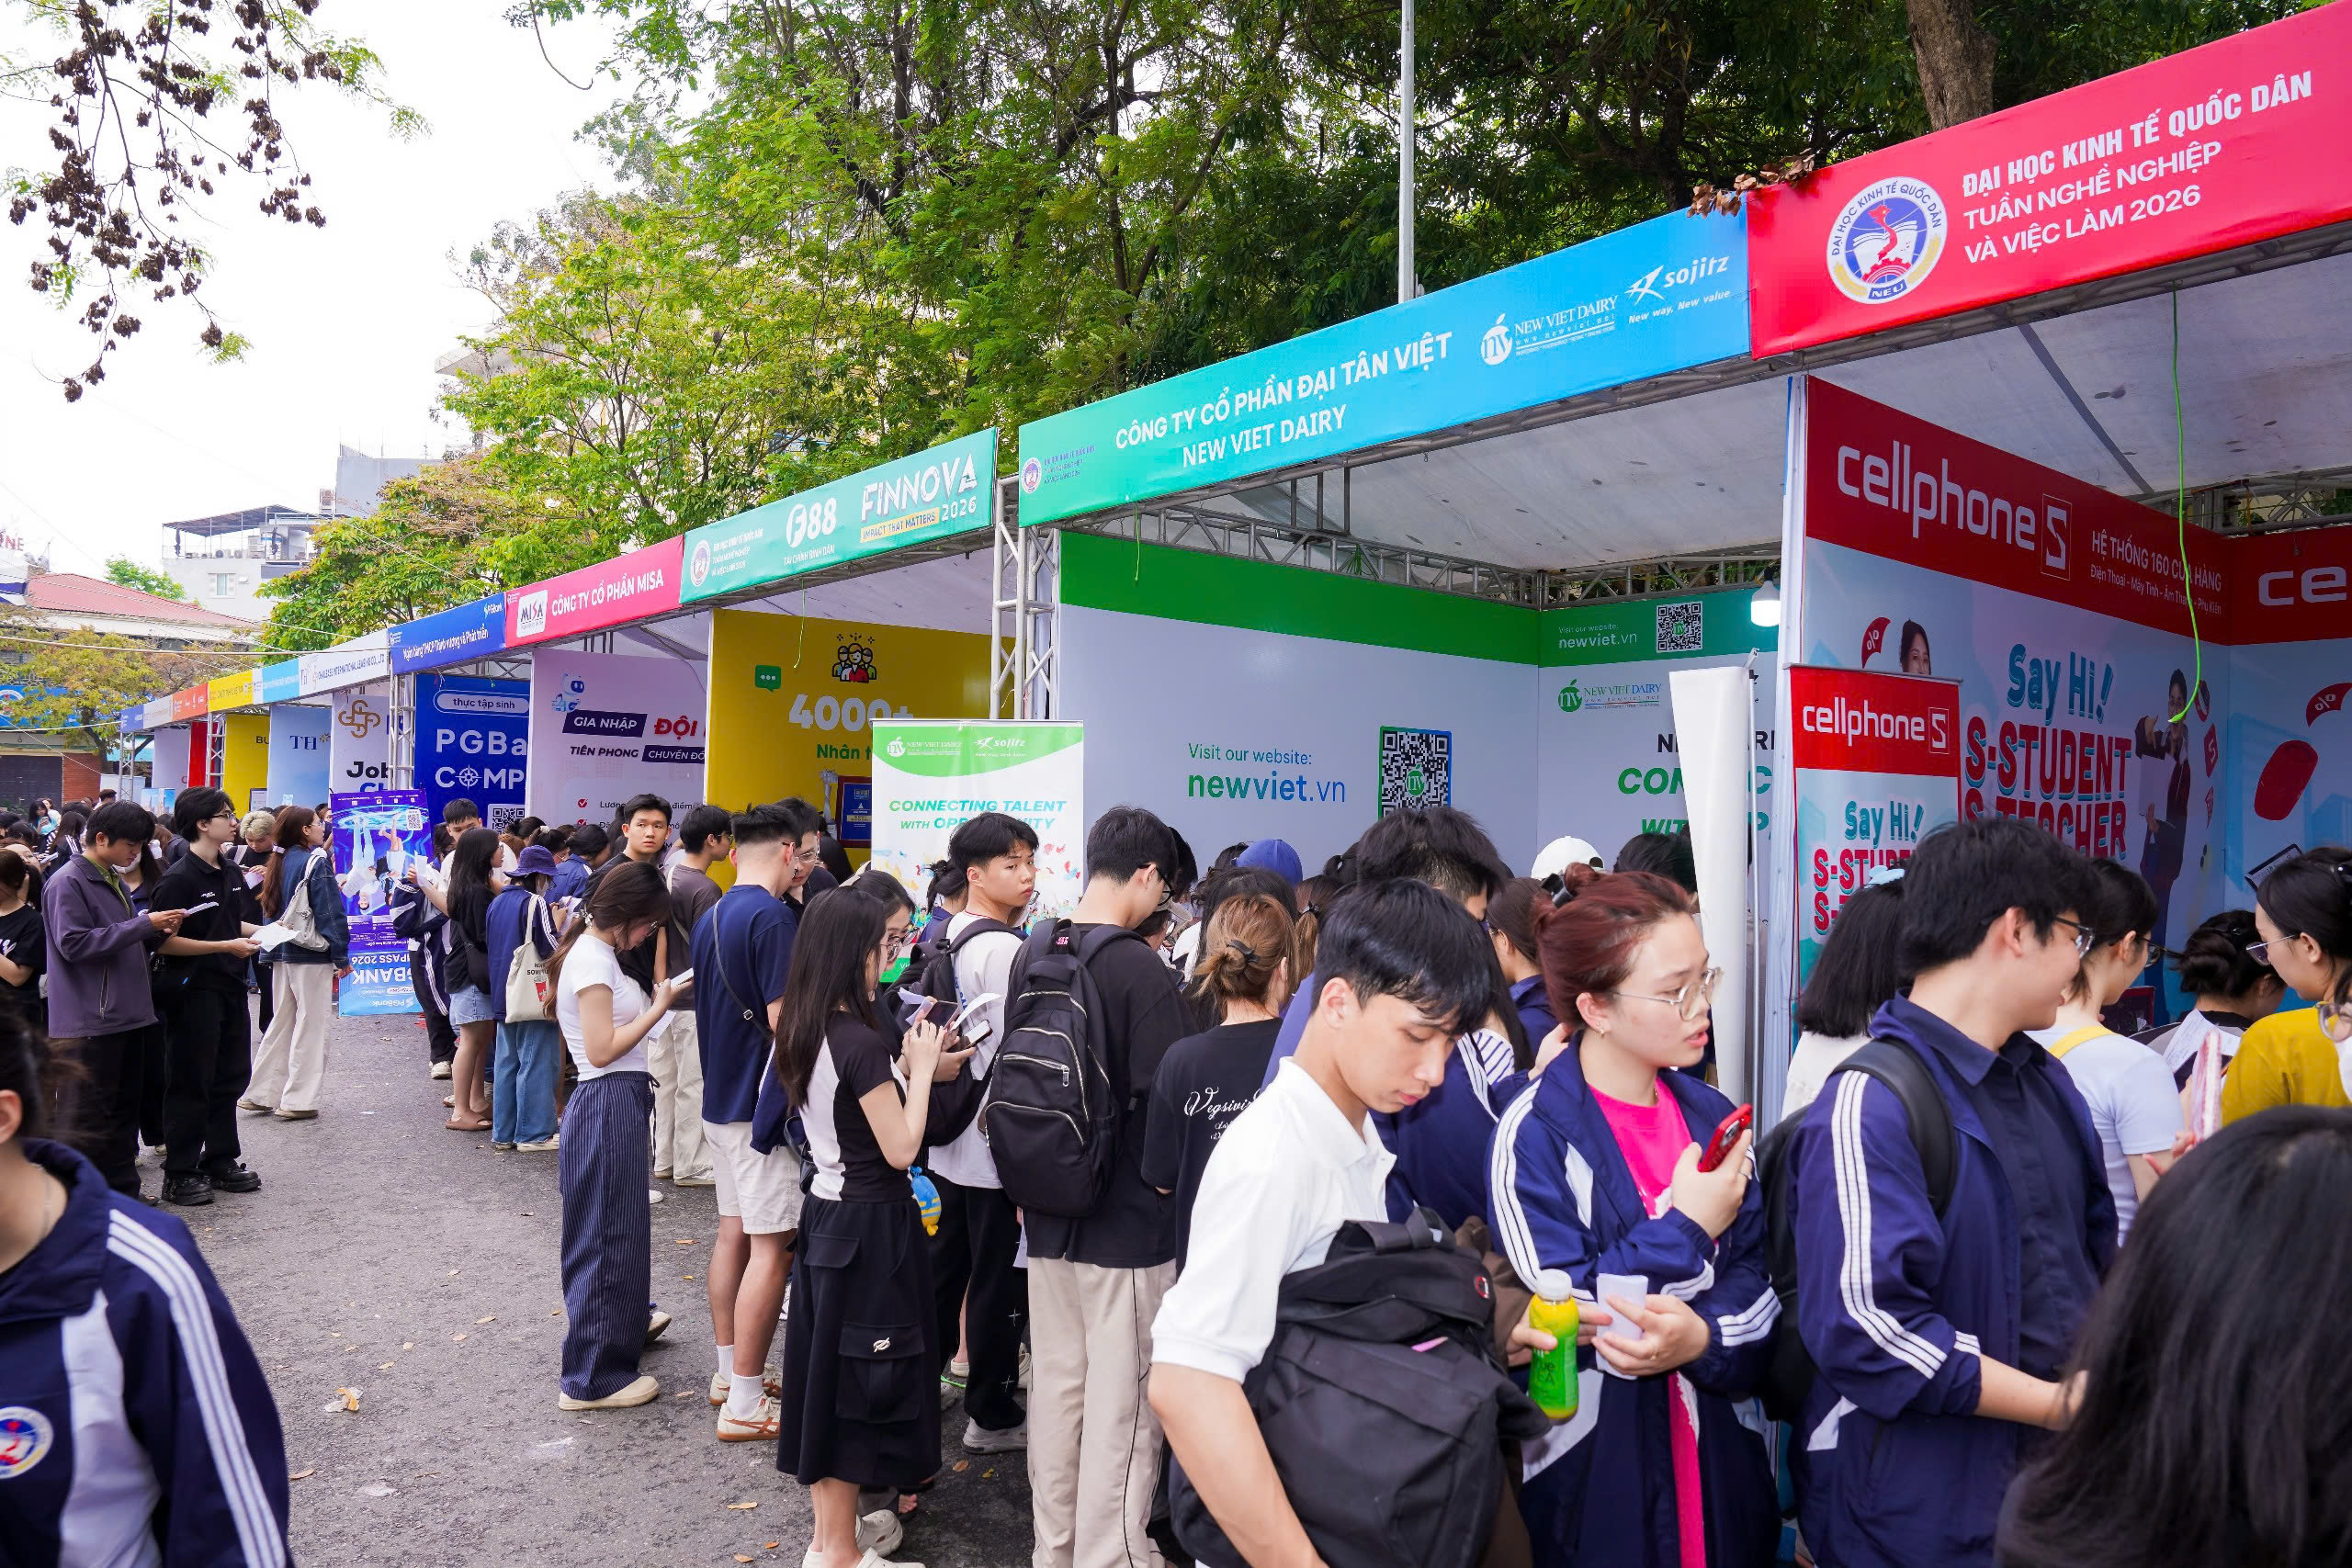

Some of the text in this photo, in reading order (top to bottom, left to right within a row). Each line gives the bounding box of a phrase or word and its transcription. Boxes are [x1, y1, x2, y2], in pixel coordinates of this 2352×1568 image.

[1962, 71, 2312, 198] ĐẠI HỌC KINH TẾ QUỐC DÂN
[1963, 141, 2222, 230] TUẦN NGHỀ NGHIỆP
[1832, 181, 1941, 255] ĐẠI HỌC KINH TẾ QUỐC DÂN
[1964, 185, 2200, 264] VÀ VIỆC LÀM 2026
[1664, 256, 1729, 288] sojitz
[1871, 283, 1904, 298] NEU
[1515, 295, 1618, 335] NEW VIET DAIRY
[1628, 312, 1649, 324] New
[1678, 299, 1700, 310] New
[1703, 290, 1730, 303] value
[1115, 332, 1453, 449] CÔNG TY CỔ PHẦN ĐẠI TÂN VIỆT
[1183, 405, 1347, 468] NEW VIET DAIRY
[861, 453, 978, 522] FINNOVA
[941, 496, 977, 522] 2026
[863, 512, 935, 540] IMPACT THAT MATTERS
[2090, 563, 2107, 583] Điện
[2092, 528, 2108, 561] HỆ
[2109, 534, 2149, 570] THỐNG
[2151, 552, 2169, 576] 160
[2194, 564, 2222, 592] HÀNG
[551, 569, 664, 616] CÔNG TY CỔ PHẦN MISA
[520, 600, 543, 622] MISA
[1558, 632, 1637, 649] newviet.vn
[1584, 683, 1662, 697] NEW VIET DAIRY
[2007, 643, 2062, 726] Say
[453, 698, 514, 709] thực tập sinh
[573, 716, 638, 731] GIA NHẬP
[653, 716, 698, 740] ĐỘI
[289, 736, 317, 750] TH
[571, 745, 639, 758] TIÊN PHONG
[817, 744, 860, 760] Nhân
[1188, 742, 1312, 765] Visit our website:
[1965, 716, 2132, 801] S-STUDENT
[1188, 770, 1346, 803] newviet.vn
[889, 800, 1066, 812] CONNECTING TALENT
[900, 820, 930, 829] WITH
[1845, 800, 1884, 850] Say
[351, 955, 378, 964] 2026
